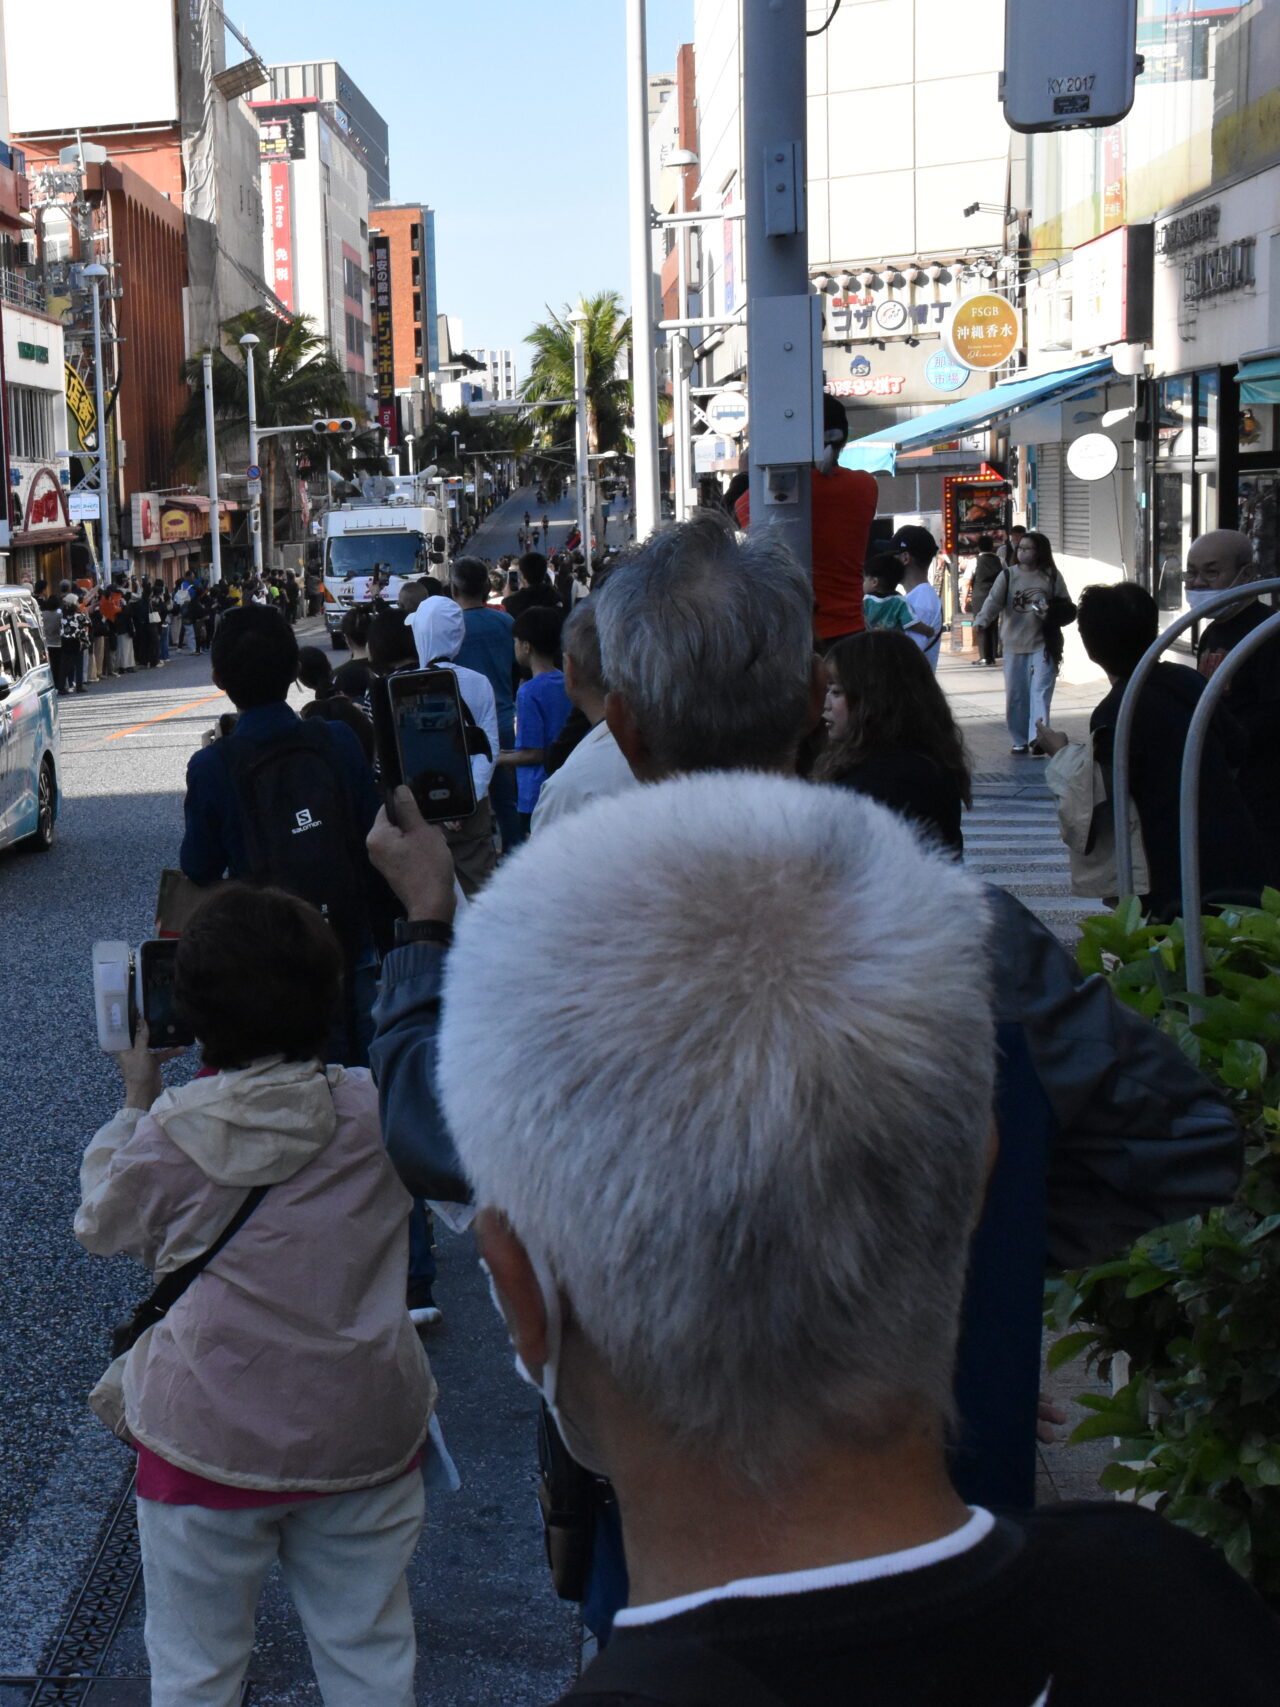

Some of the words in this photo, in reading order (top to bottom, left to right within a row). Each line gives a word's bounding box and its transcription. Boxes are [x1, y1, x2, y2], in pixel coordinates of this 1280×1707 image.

[1047, 76, 1064, 94] KY
[1066, 73, 1096, 93] 2017
[274, 185, 285, 204] Tax
[275, 205, 285, 228] Free
[275, 247, 289, 281] 免税
[831, 305, 877, 332] コザ
[971, 305, 1000, 318] FSGB
[956, 323, 1015, 340] 沖縄香水
